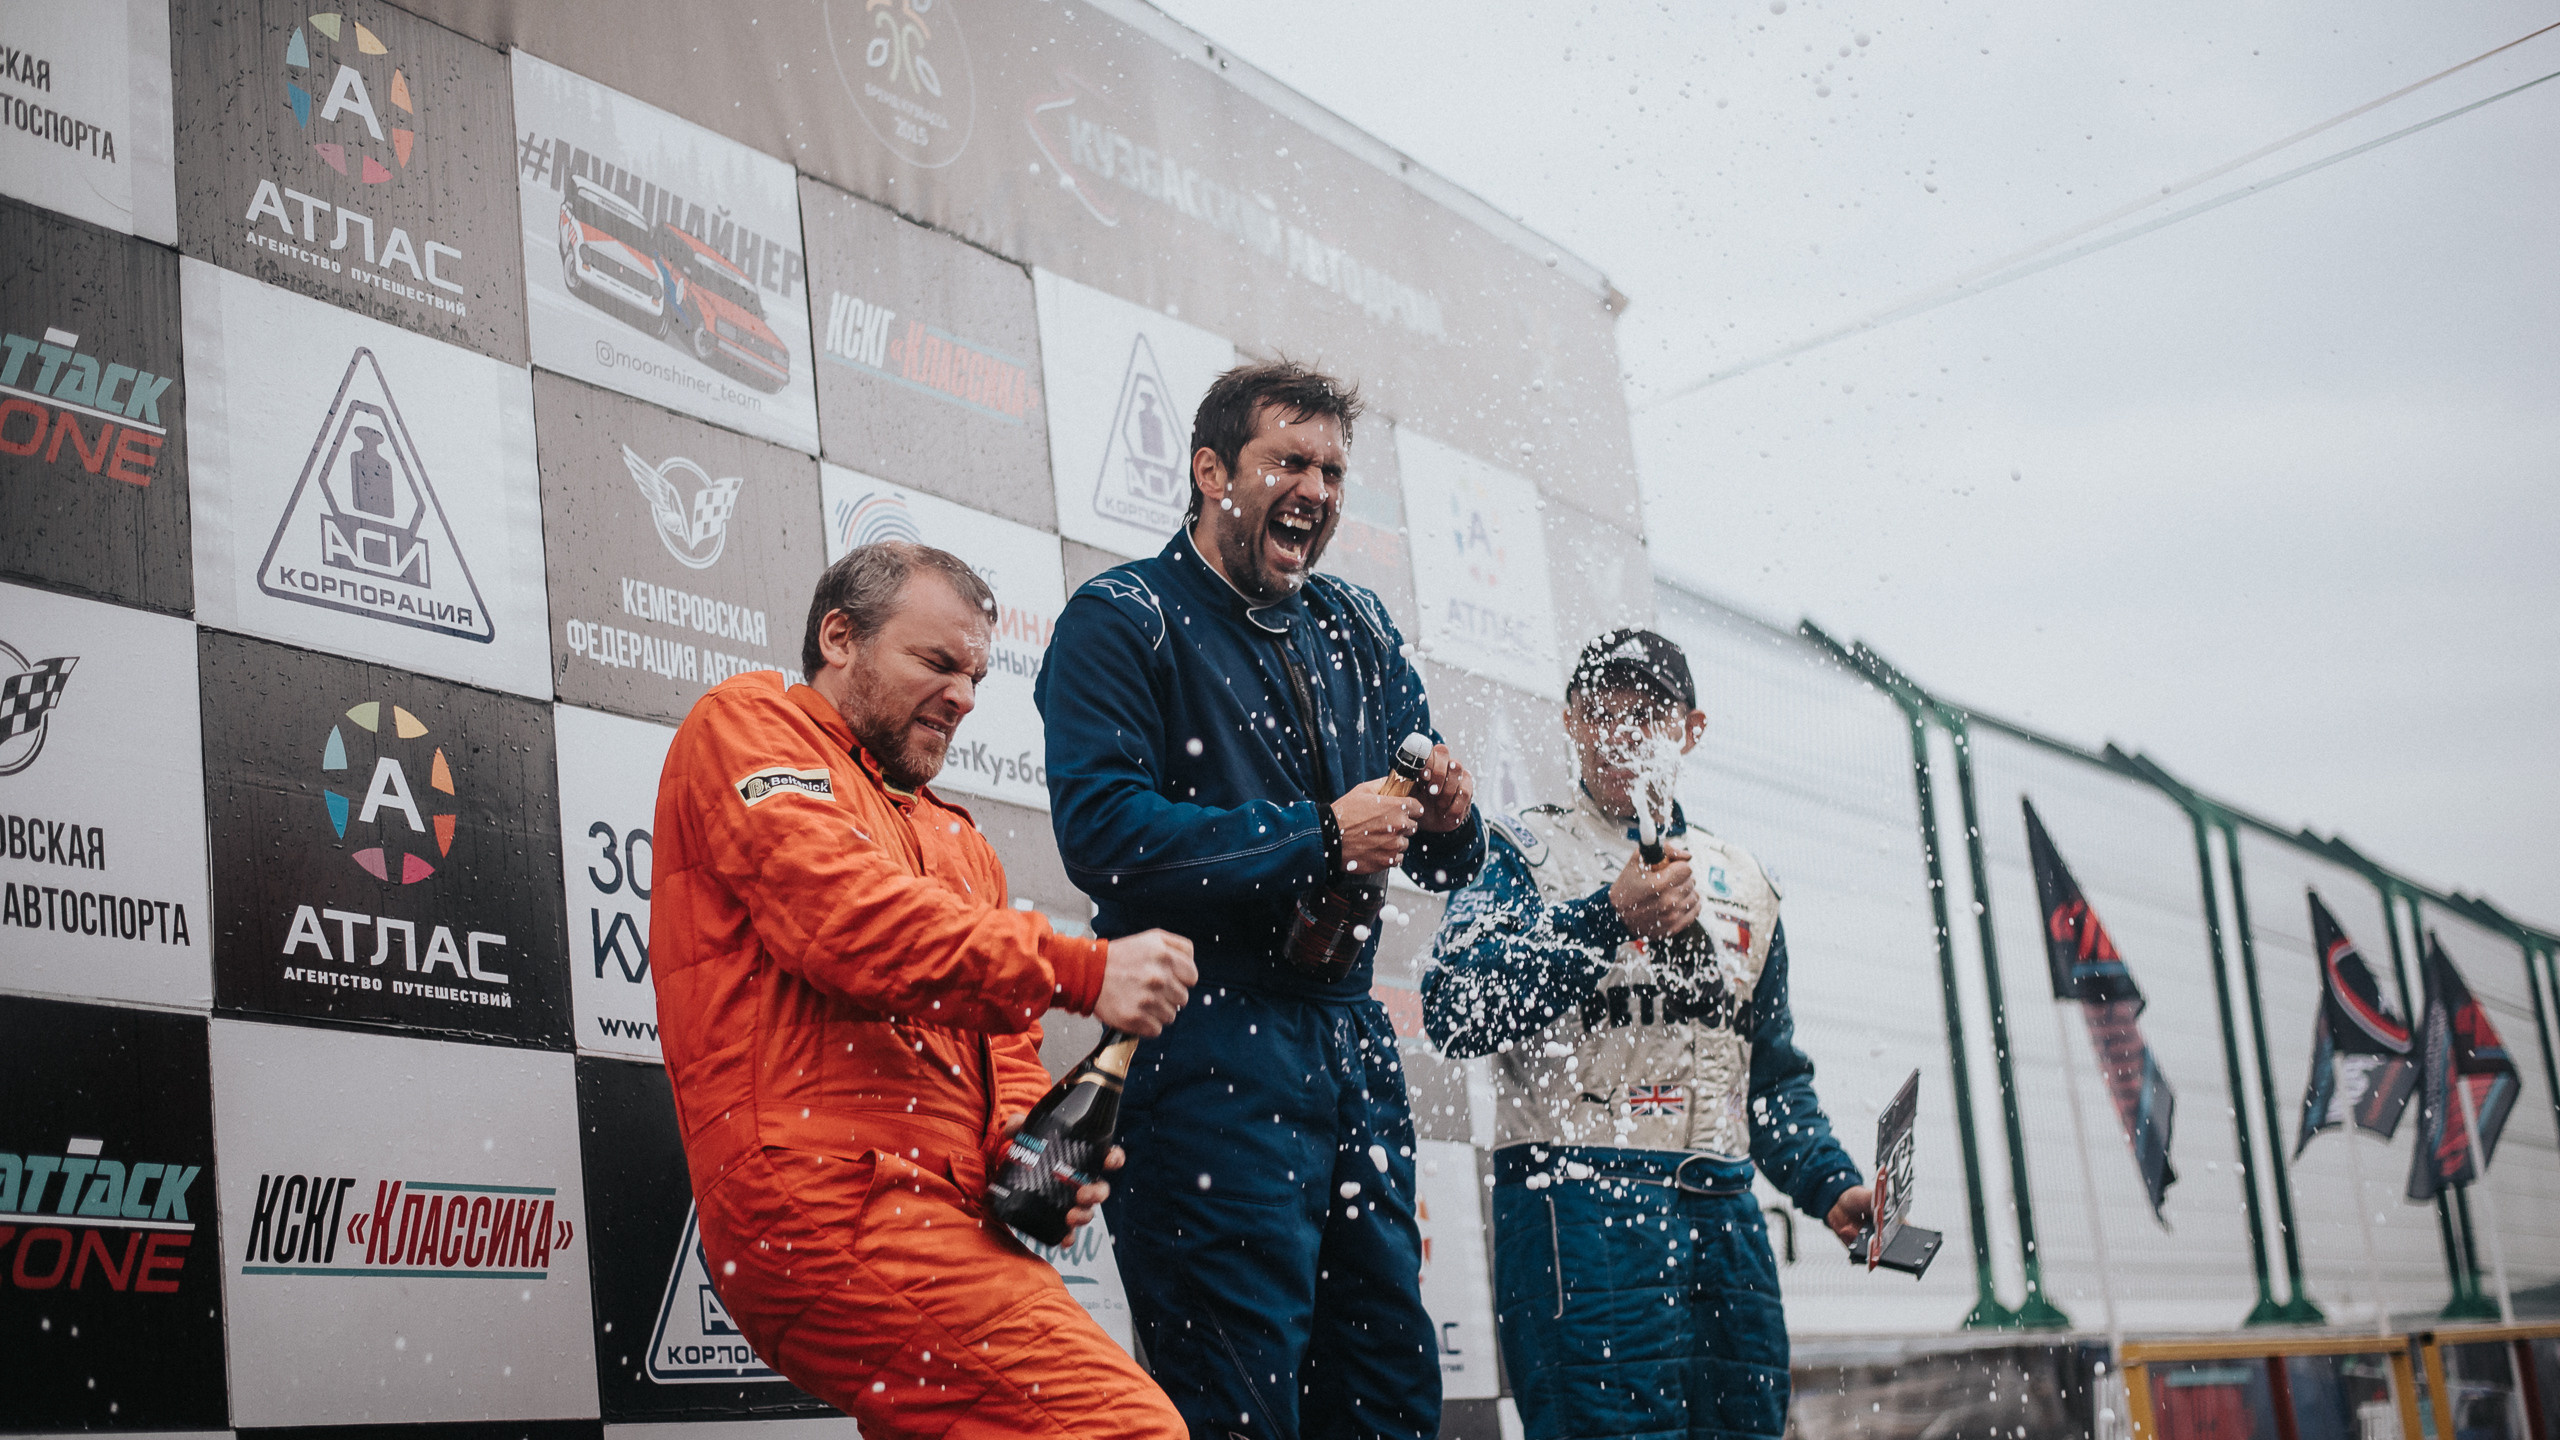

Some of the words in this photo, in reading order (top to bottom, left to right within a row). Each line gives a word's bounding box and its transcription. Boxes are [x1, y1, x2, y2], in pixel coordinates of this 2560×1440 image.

[245, 179, 464, 295] АТЛАС
[246, 231, 342, 275] АГЕНТСТВО
[350, 266, 467, 318] ПУТЕШЕСТВИЙ
[825, 290, 897, 370] КСКГ
[279, 565, 475, 627] КОРПОРАЦИЯ
[621, 576, 768, 648] КЕМЕРОВСКАЯ
[566, 618, 699, 683] ФЕДЕРАЦИЯ
[2, 881, 191, 947] АВТОСПОРТА
[282, 904, 510, 985] АТЛАС
[283, 966, 383, 993] АГЕНТСТВО
[392, 979, 512, 1009] ПУТЕШЕСТВИЙ
[245, 1173, 357, 1264] КСКГ
